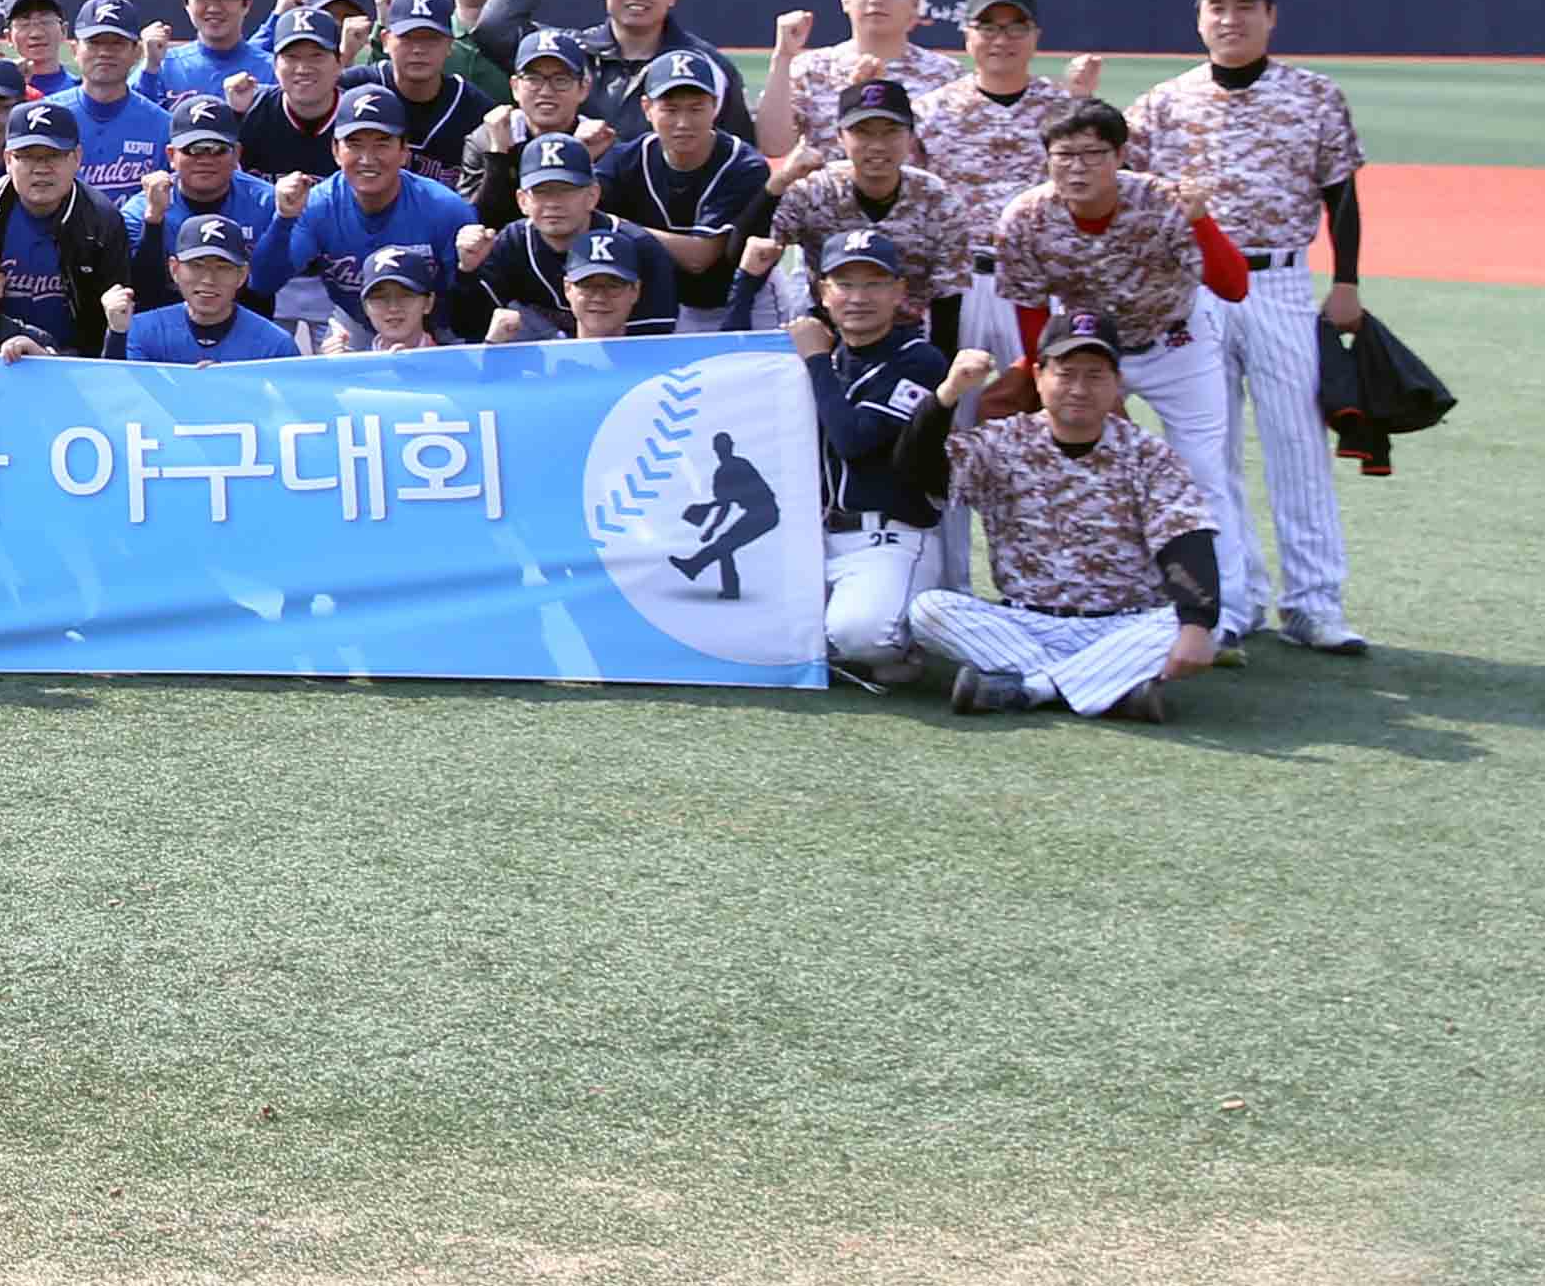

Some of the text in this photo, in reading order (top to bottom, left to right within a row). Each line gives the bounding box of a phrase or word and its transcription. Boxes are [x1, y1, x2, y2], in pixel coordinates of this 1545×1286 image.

[293, 10, 315, 31] K
[536, 29, 561, 51] K
[671, 55, 695, 78] K
[541, 141, 566, 166] K
[589, 235, 615, 262] K
[50, 411, 502, 523] 야구대회
